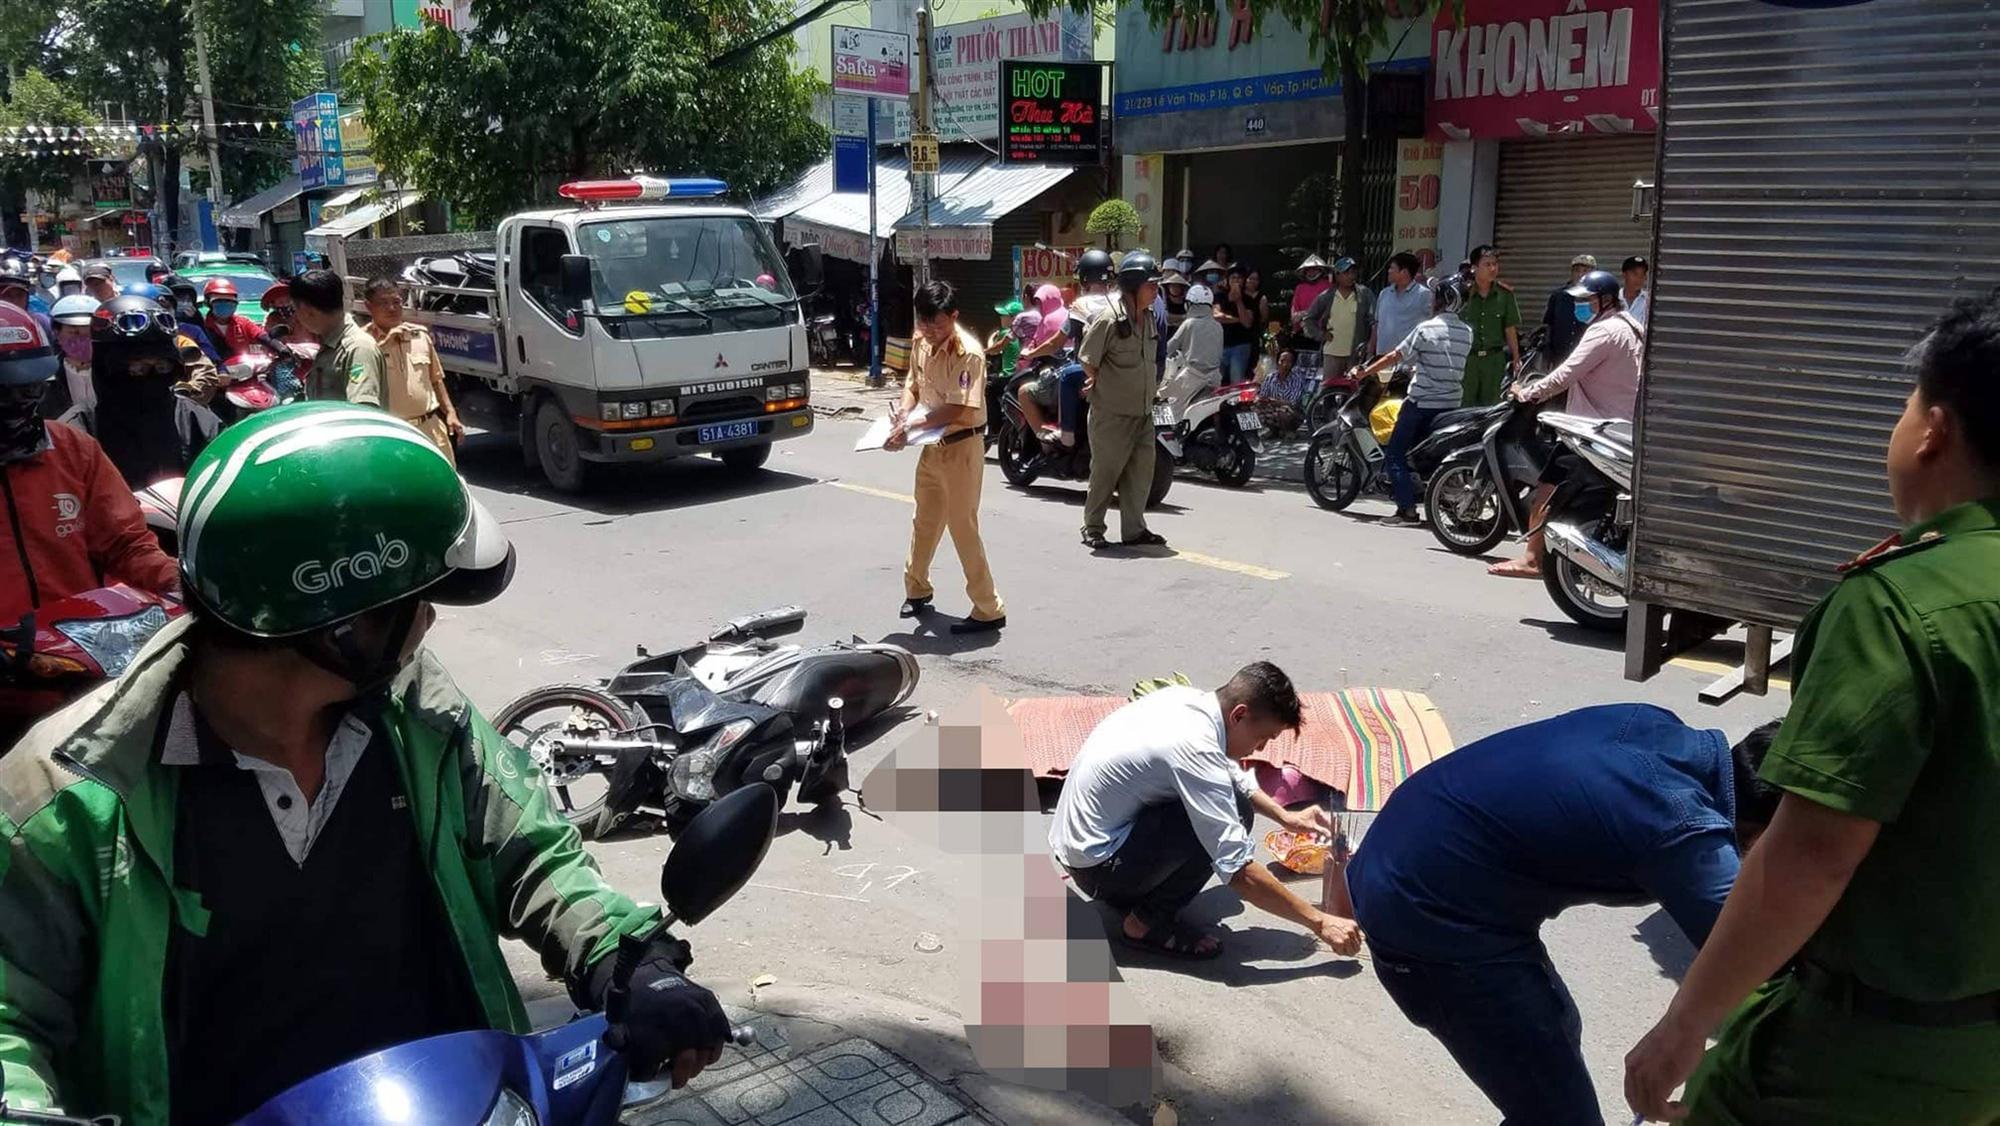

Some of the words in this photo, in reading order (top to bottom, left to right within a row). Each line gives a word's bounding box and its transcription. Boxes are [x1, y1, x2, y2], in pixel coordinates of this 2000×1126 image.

[836, 54, 876, 77] SaRa
[1012, 70, 1065, 98] HOT
[1011, 100, 1055, 124] Thu
[1247, 118, 1264, 130] 440
[1399, 174, 1440, 211] 50
[751, 360, 788, 371] CANTER
[680, 378, 764, 396] MITSUBISHI
[702, 422, 753, 441] 51A-4381
[292, 531, 409, 594] Grab
